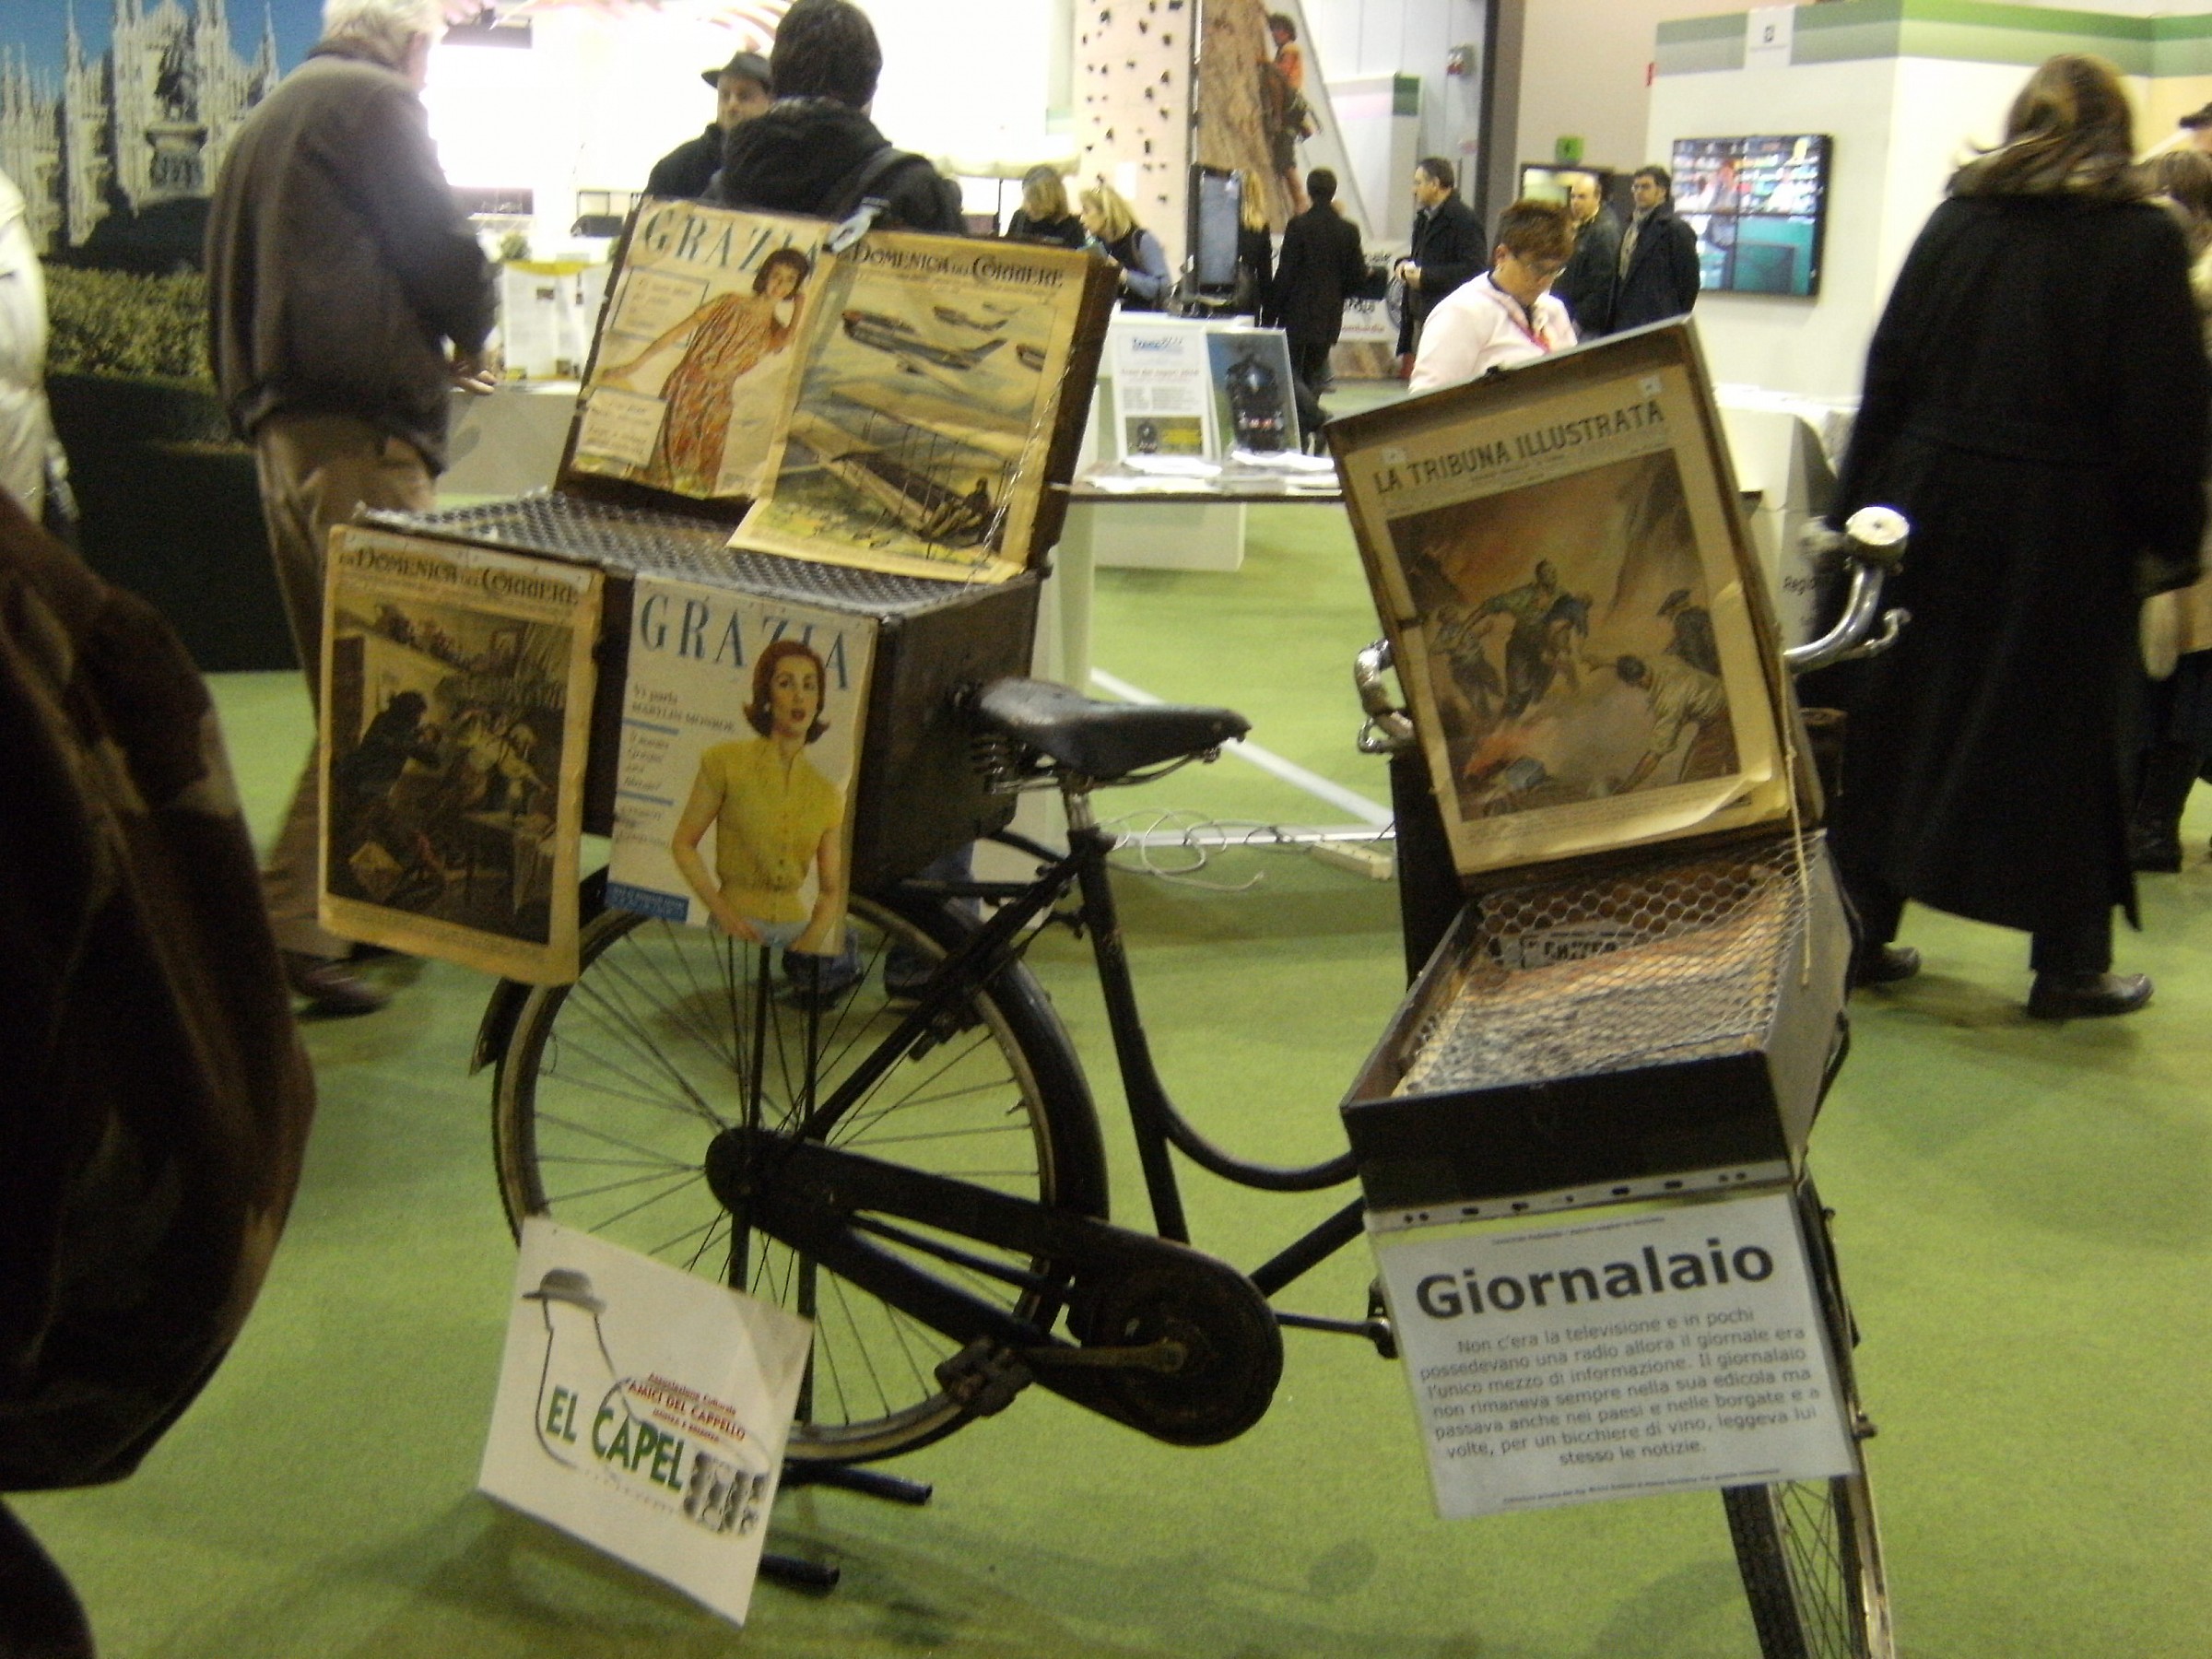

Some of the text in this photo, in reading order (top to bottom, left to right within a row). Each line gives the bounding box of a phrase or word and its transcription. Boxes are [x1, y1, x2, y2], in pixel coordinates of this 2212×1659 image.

[1372, 399, 1665, 495] LA TRIBUNA ILLUSTRATA
[1416, 1237, 1774, 1319] Giornalaio
[1420, 1326, 1806, 1382] possedevano una radio allora il giornale era
[1457, 1338, 1491, 1354] Non
[1546, 1329, 1560, 1344] la
[1566, 1318, 1660, 1343] televisione
[1667, 1317, 1677, 1328] e
[1684, 1312, 1700, 1326] in
[1707, 1307, 1754, 1328] pochi
[1429, 1346, 1806, 1400] l'unico mezzo di informazione. Il giornalaio
[1433, 1367, 1811, 1418] non rimaneva sempre nella sua edicola ma
[546, 1383, 579, 1444] EL
[628, 1379, 663, 1404] AMICI
[665, 1394, 686, 1412] DEL
[690, 1406, 747, 1441] CAPPELLO
[1435, 1387, 1820, 1441] passava anche nei paesi e nelle borgate e a
[1446, 1405, 1817, 1459] volte, per un bicchiere di vino, leggeva lui
[1559, 1438, 1705, 1466] stesso le notizie.
